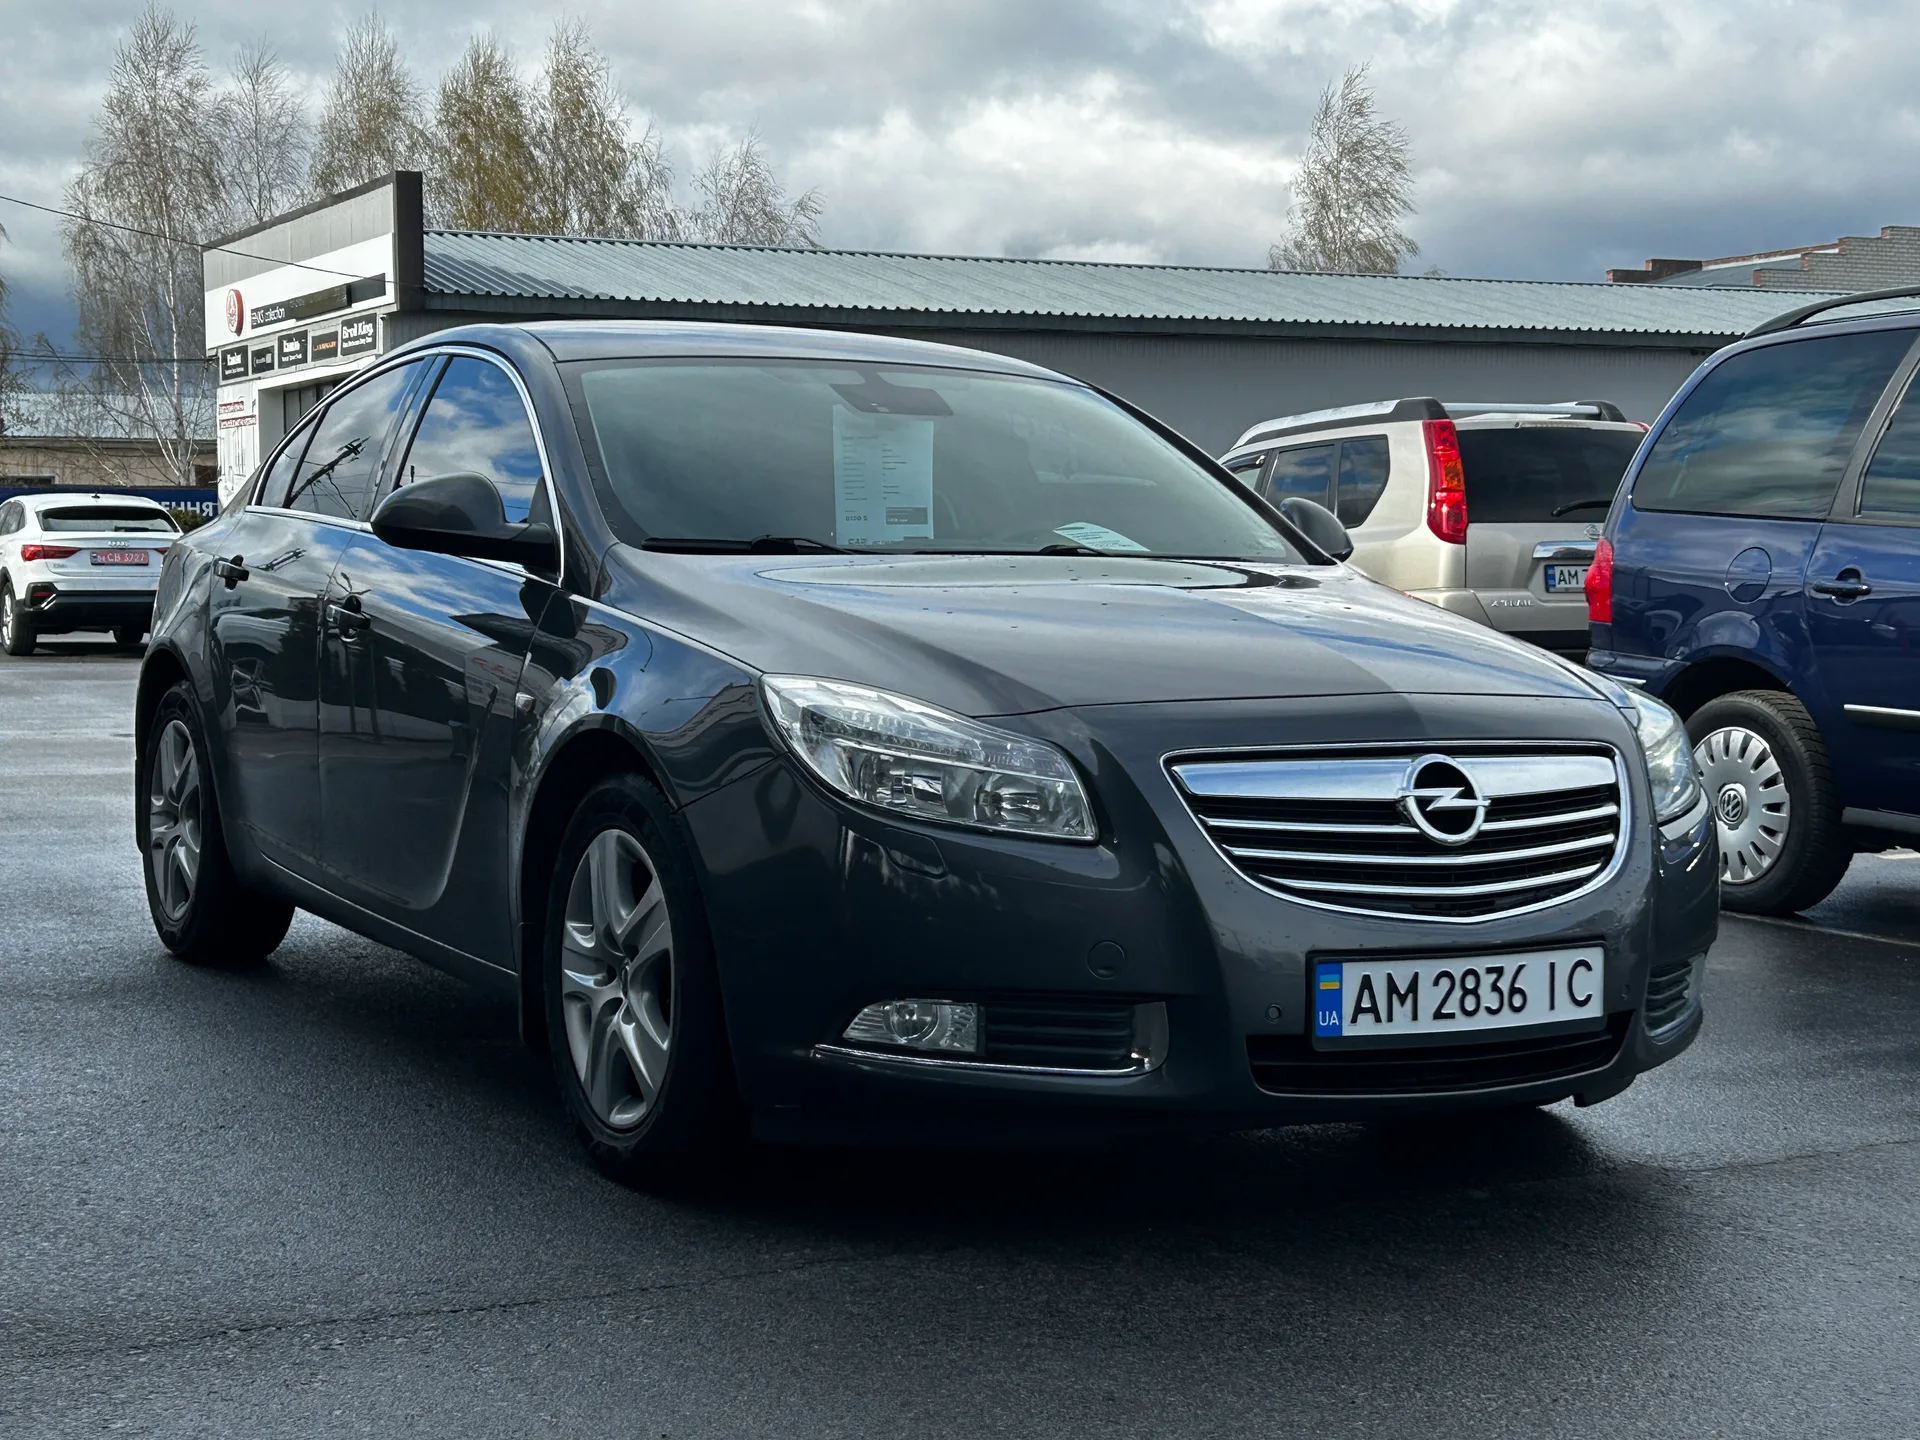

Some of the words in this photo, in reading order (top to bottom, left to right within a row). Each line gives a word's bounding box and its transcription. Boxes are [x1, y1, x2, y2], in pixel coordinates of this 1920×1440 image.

[1557, 569, 1579, 585] AM
[1349, 970, 1419, 1024] AM
[1432, 963, 1528, 1021] 2836
[1548, 957, 1593, 1012] IC
[1318, 1010, 1340, 1027] UA
